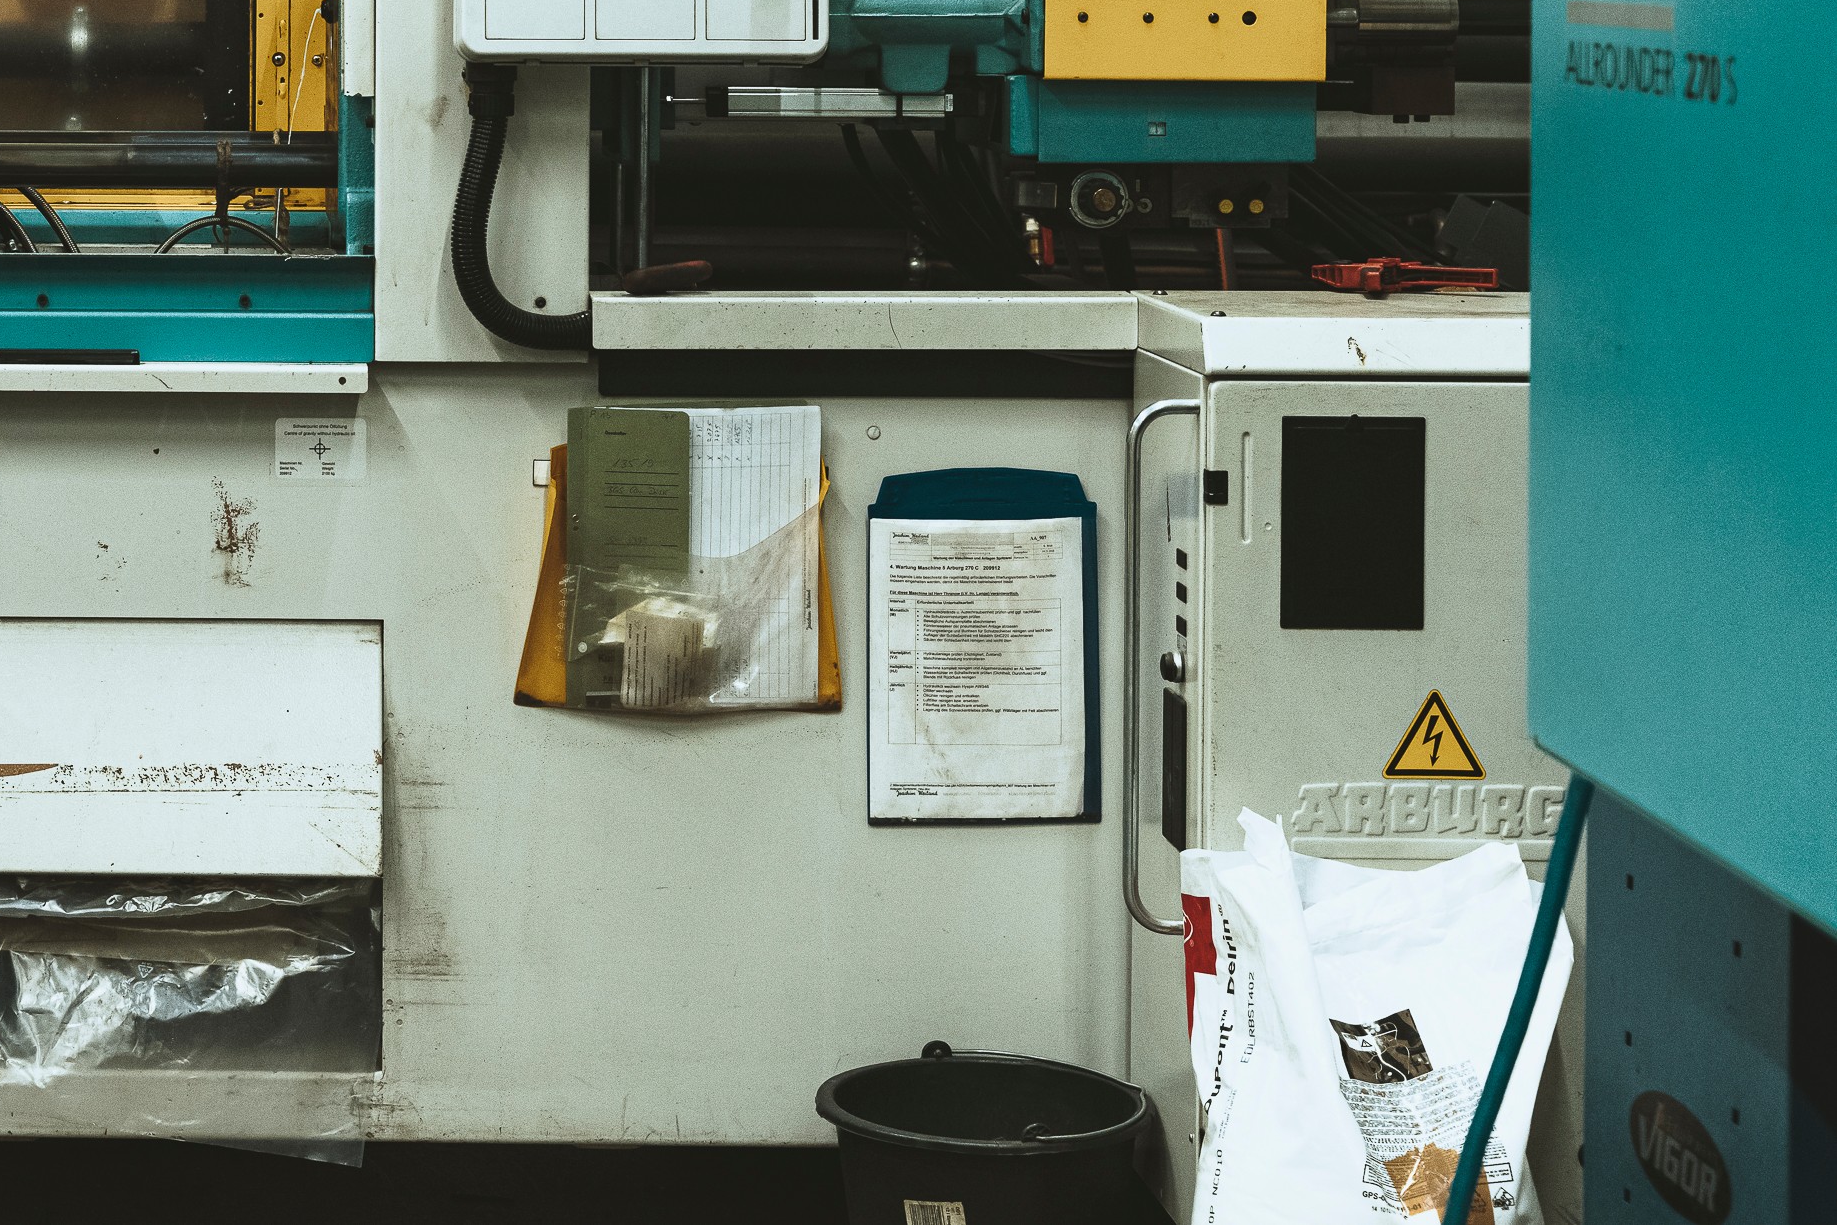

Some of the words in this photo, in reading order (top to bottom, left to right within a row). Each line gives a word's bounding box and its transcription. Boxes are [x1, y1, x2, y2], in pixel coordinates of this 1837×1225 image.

[1684, 51, 1722, 104] 270
[1725, 54, 1739, 107] S
[1291, 783, 1565, 838] ARBURG
[1639, 1101, 1717, 1213] VIGOR
